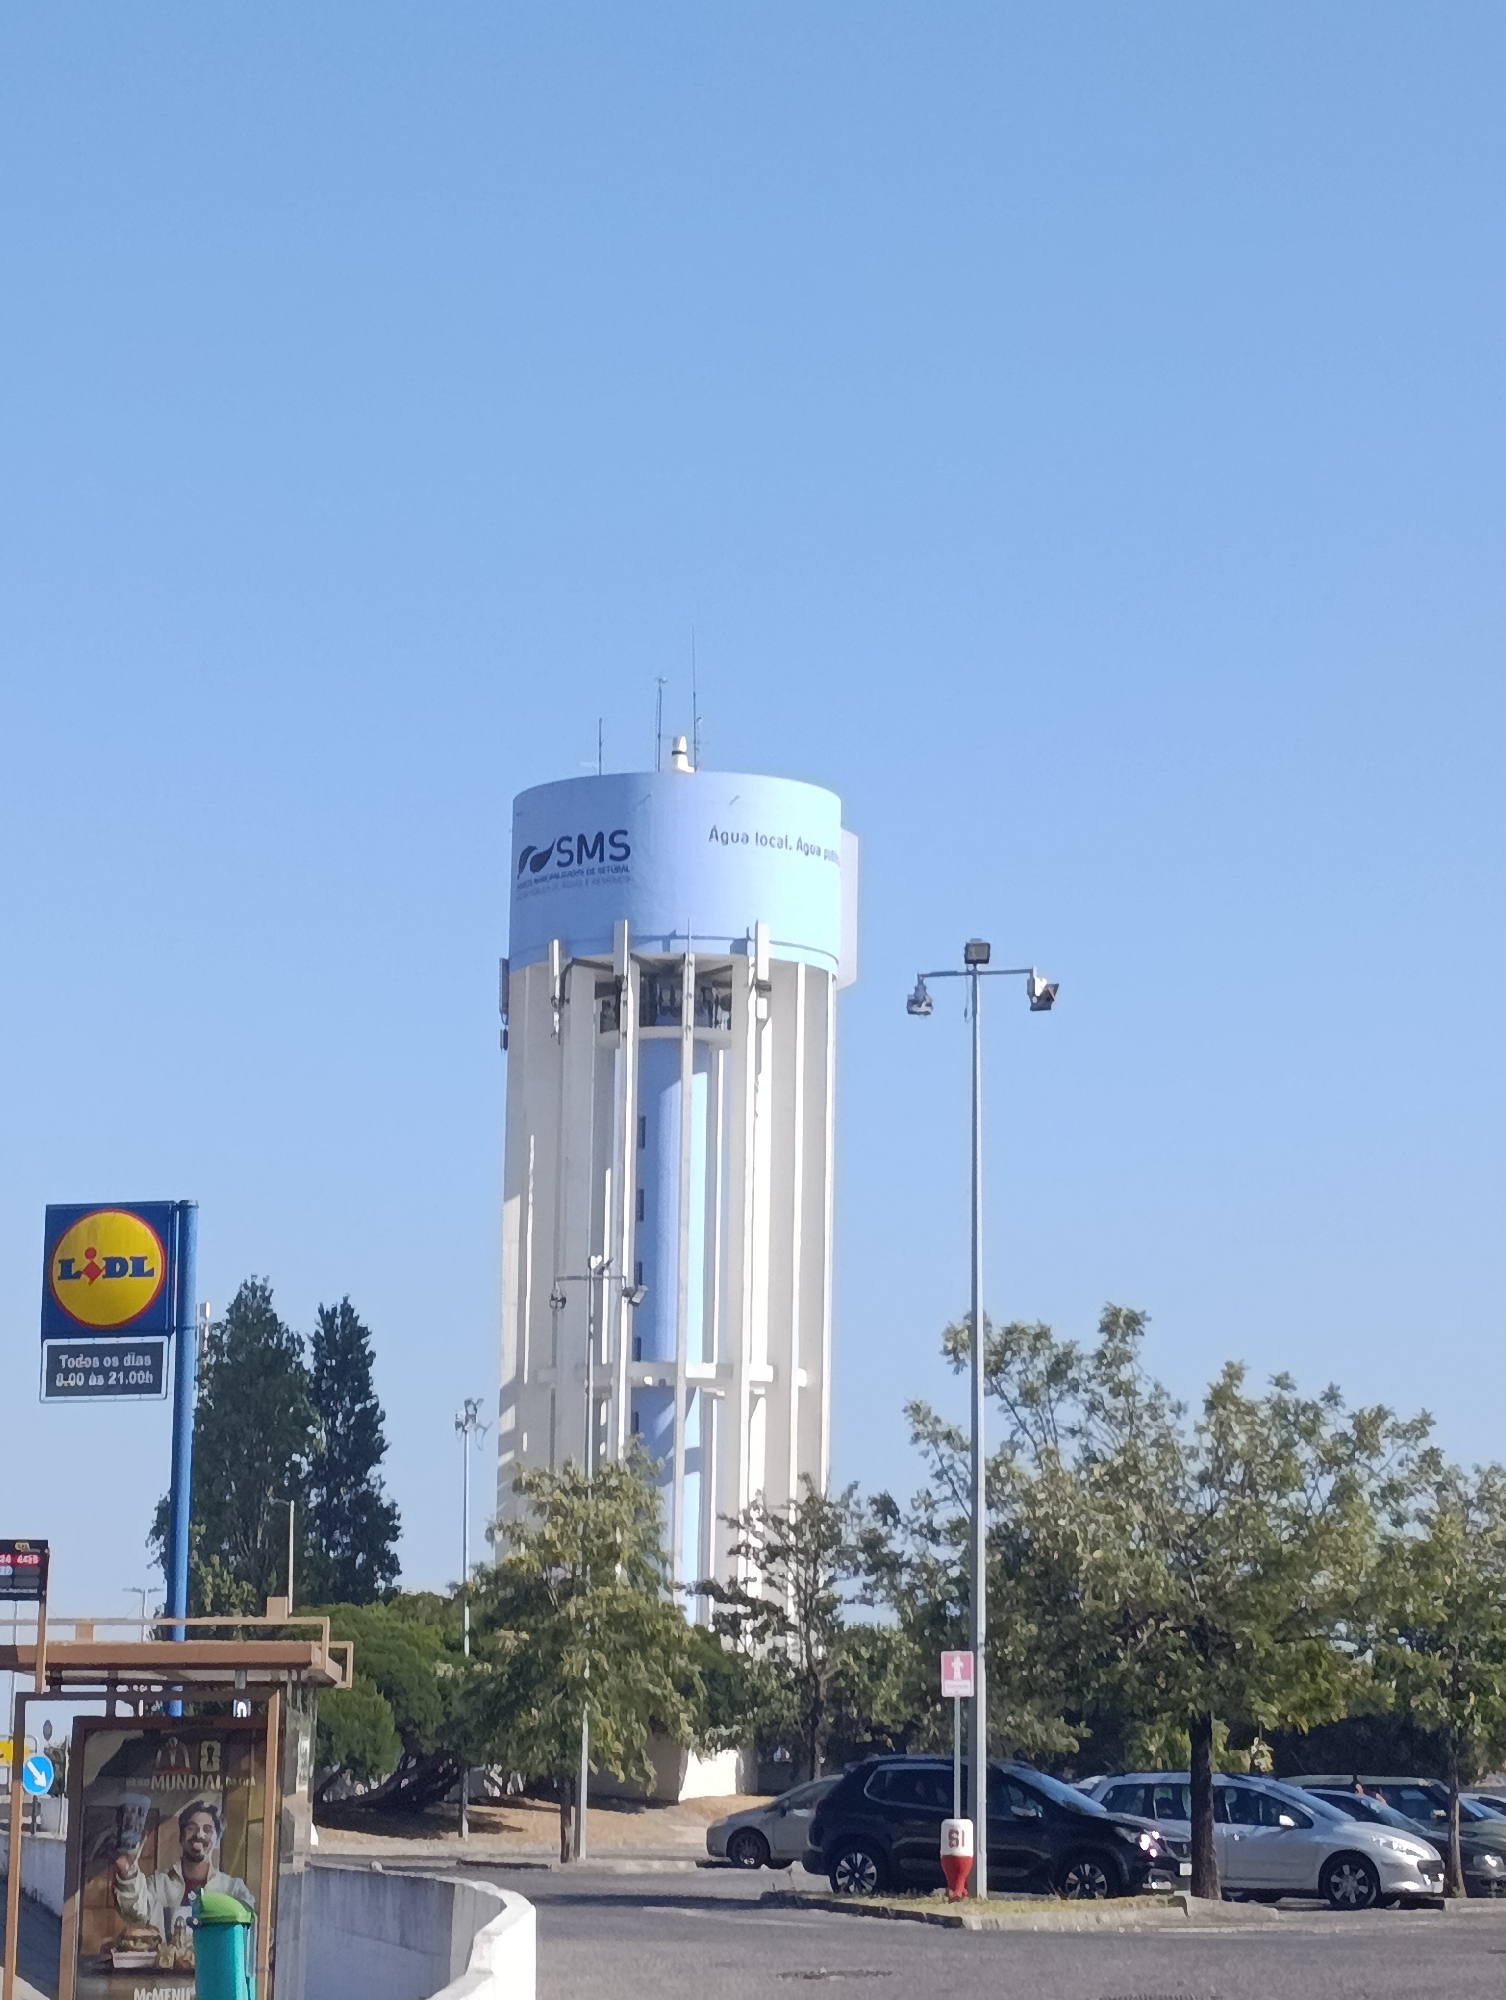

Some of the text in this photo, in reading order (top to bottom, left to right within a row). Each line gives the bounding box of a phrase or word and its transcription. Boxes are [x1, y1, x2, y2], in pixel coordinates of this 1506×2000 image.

[556, 828, 631, 869] SMS
[58, 1351, 152, 1369] Todos os dias
[150, 1773, 224, 1791] MUNDIAL
